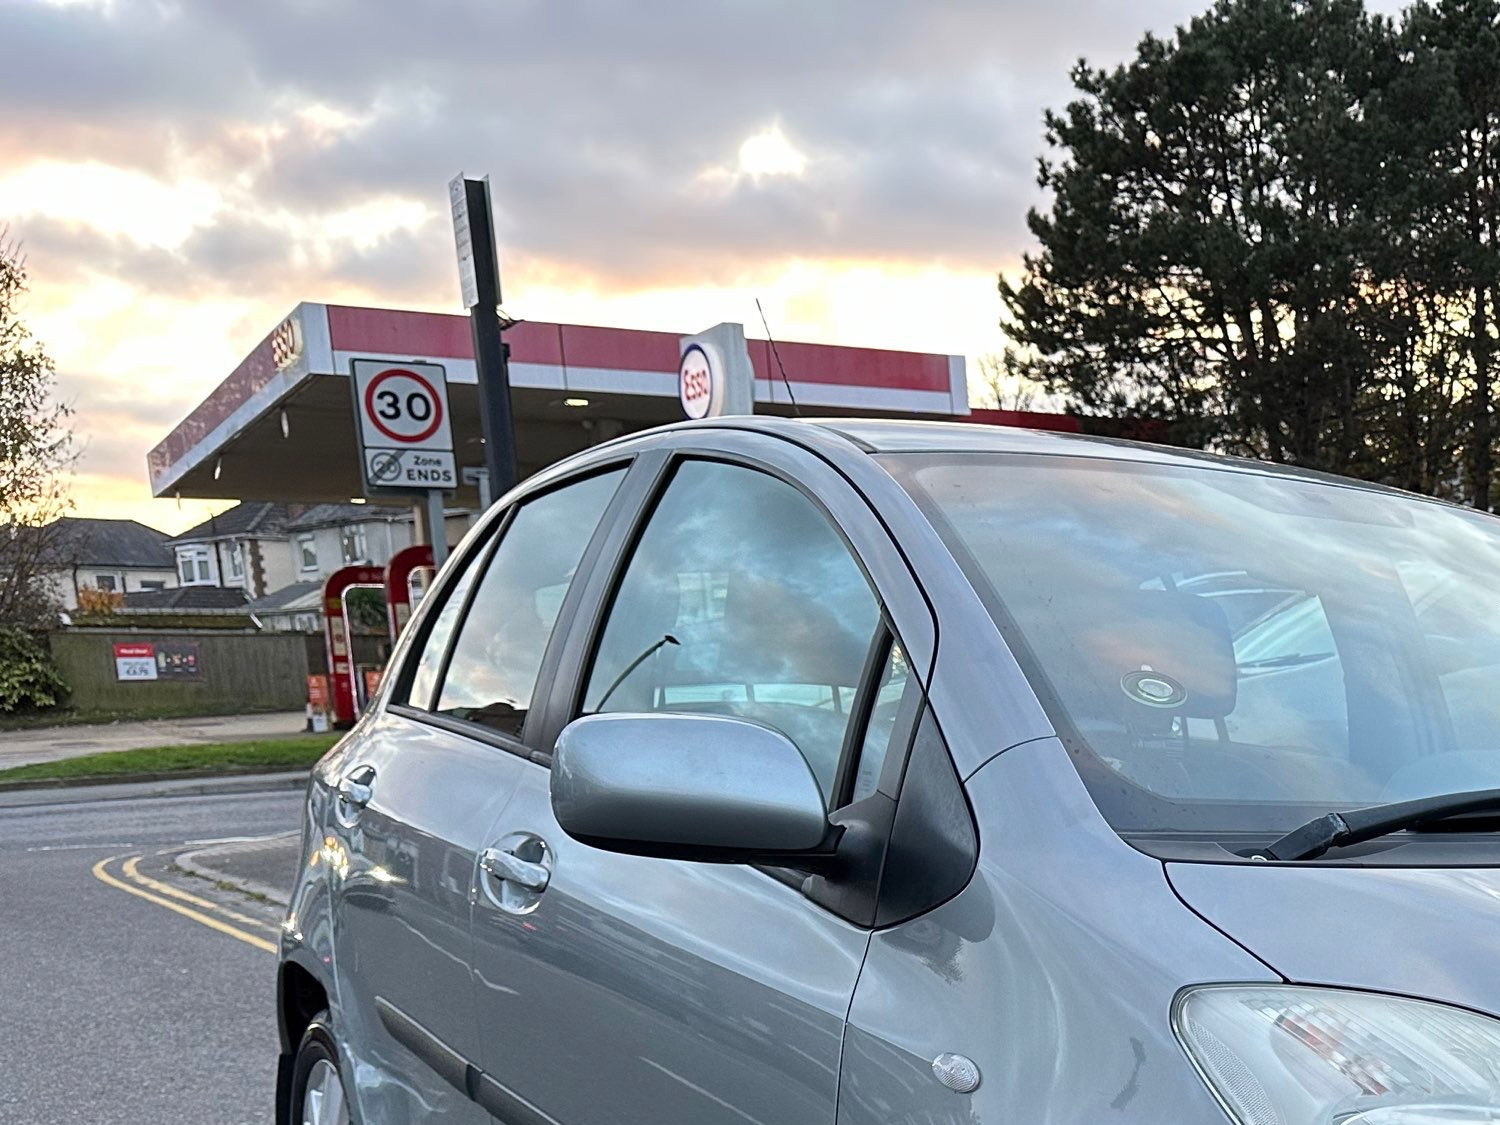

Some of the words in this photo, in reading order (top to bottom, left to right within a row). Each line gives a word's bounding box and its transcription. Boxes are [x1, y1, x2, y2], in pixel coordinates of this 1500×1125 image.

[684, 369, 708, 401] Esso
[377, 390, 431, 421] 30
[413, 455, 442, 467] Zone
[406, 467, 452, 482] ENDS
